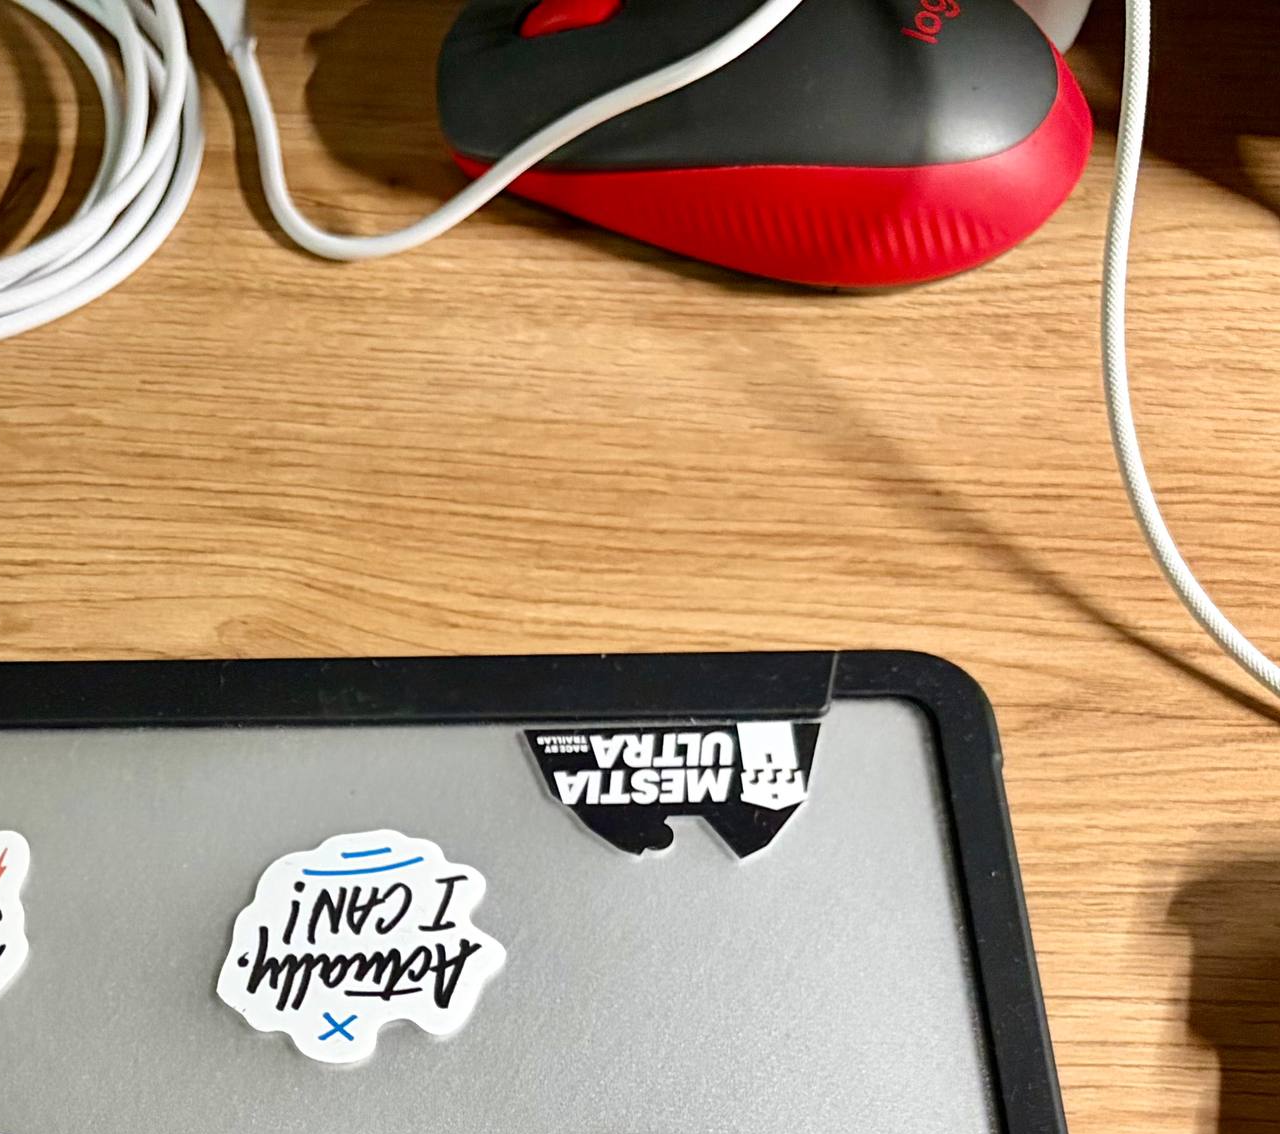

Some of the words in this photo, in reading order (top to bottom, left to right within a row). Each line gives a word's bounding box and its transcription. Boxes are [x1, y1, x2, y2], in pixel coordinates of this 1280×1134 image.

[589, 731, 734, 768] ULTRA
[553, 767, 734, 805] MESTIA
[282, 881, 413, 944] CAN!
[418, 875, 468, 932] I
